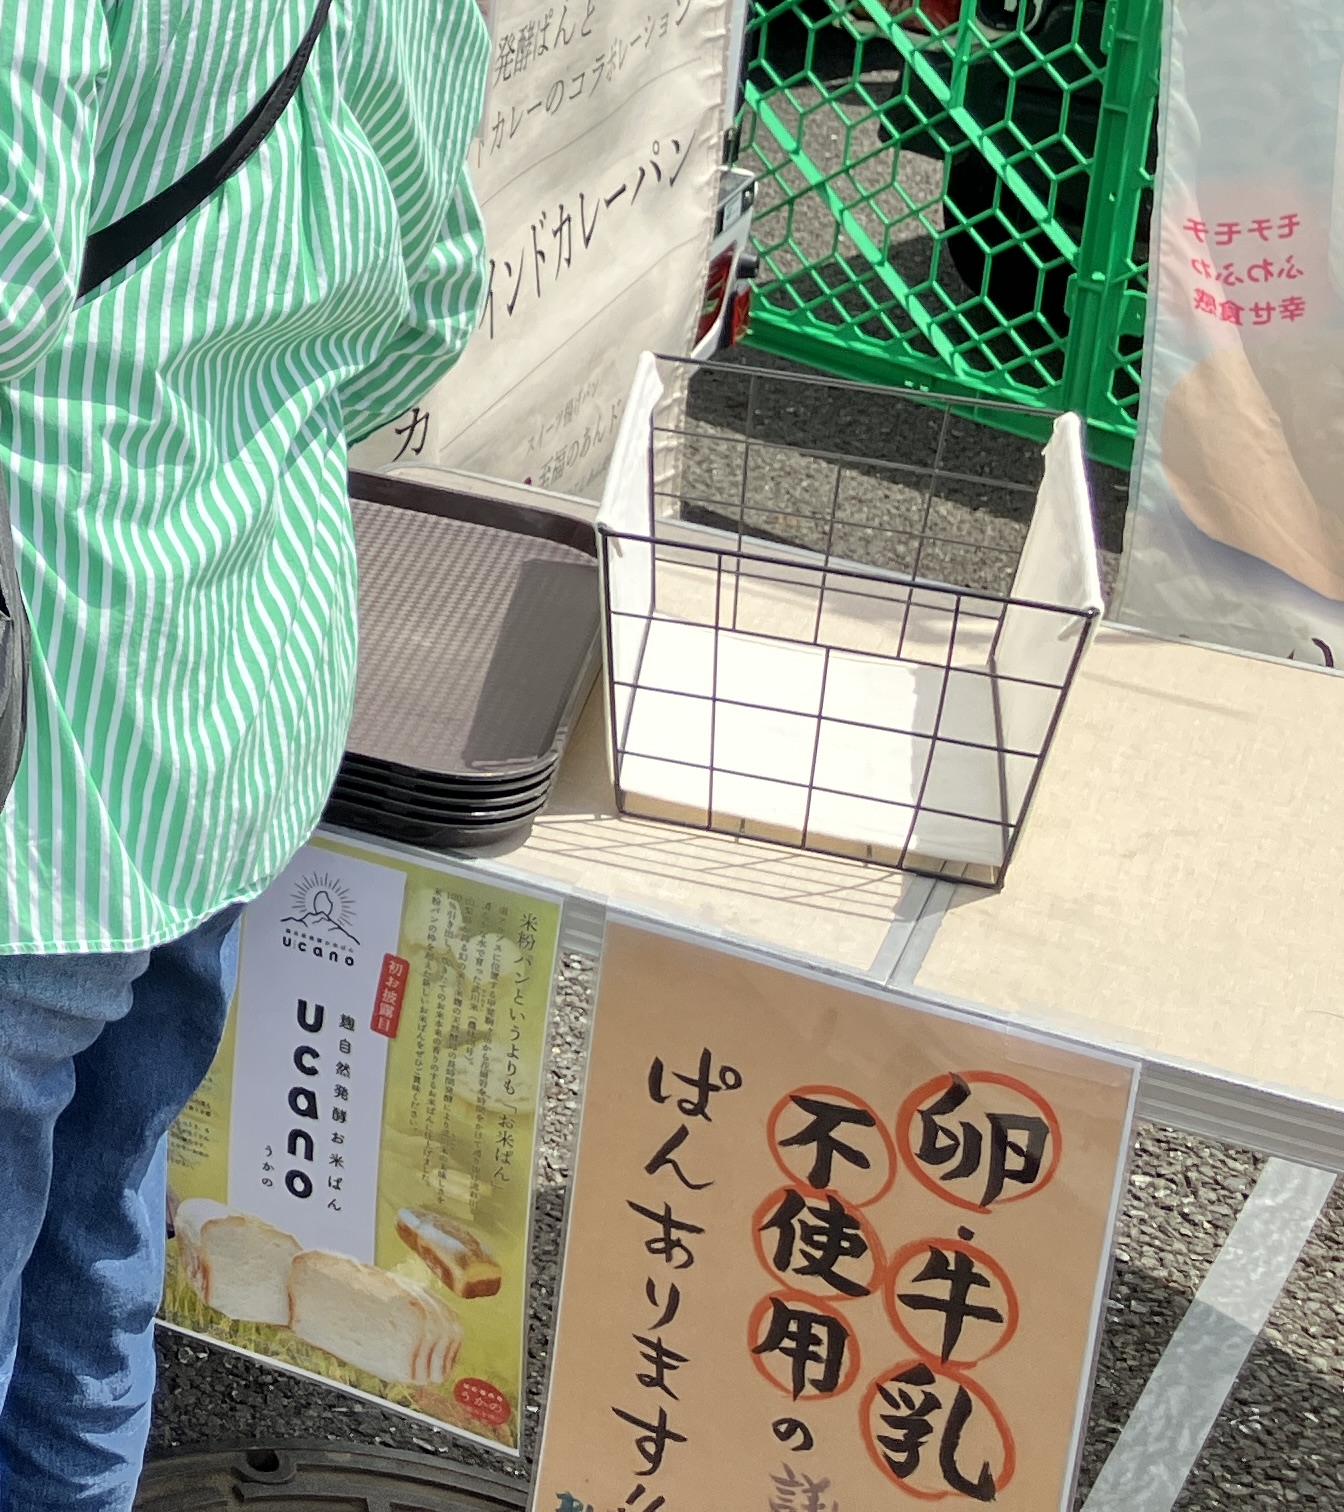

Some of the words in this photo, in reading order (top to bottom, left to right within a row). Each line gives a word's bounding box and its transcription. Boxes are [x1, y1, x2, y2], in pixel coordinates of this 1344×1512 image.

[479, 128, 700, 341] インドカレーパン
[281, 935, 355, 968] ucano
[261, 1144, 276, 1189] うかの
[284, 998, 326, 1201] ucano
[326, 1012, 356, 1213] 麹自然発酵お米ぱん
[875, 1071, 1053, 1502] 卵・牛乳
